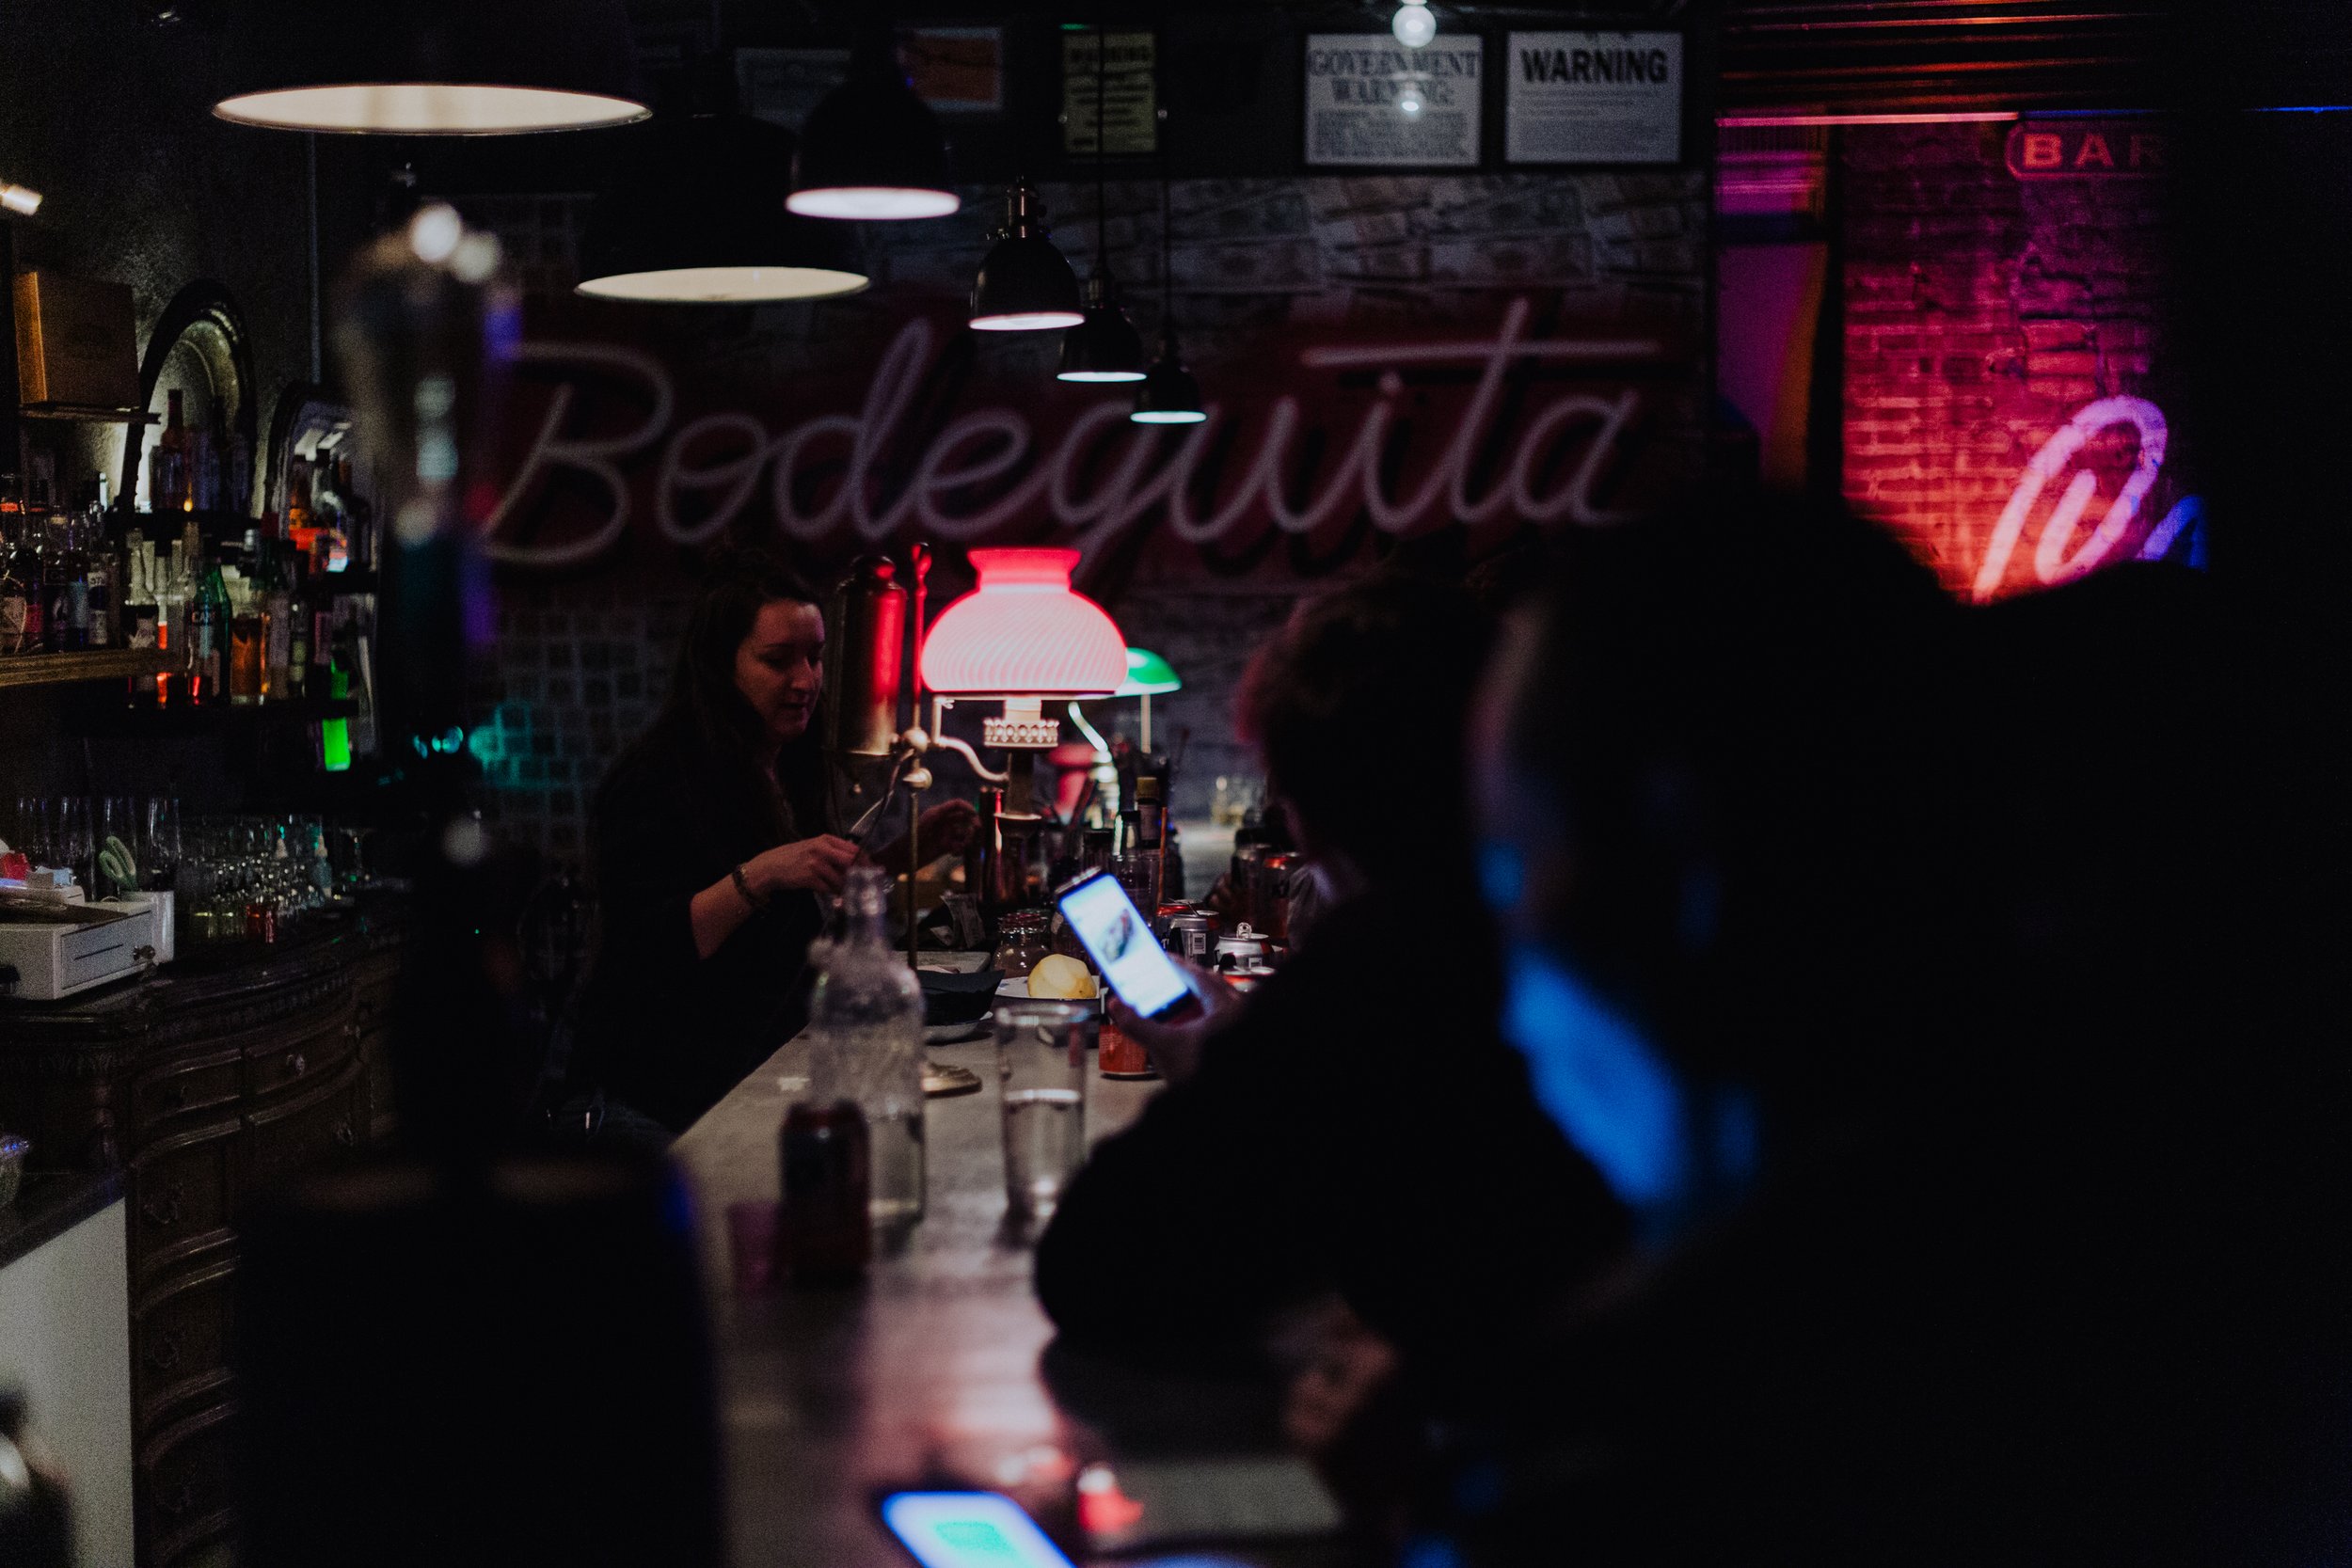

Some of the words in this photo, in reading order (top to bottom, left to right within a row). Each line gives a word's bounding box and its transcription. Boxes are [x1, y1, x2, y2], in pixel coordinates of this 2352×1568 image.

[1309, 50, 1479, 77] GOVERNMENT
[1520, 49, 1668, 84] WARNING
[1331, 78, 1455, 104] WARNNG
[2023, 132, 2166, 167] BAR
[482, 298, 1662, 583] Bodeguita
